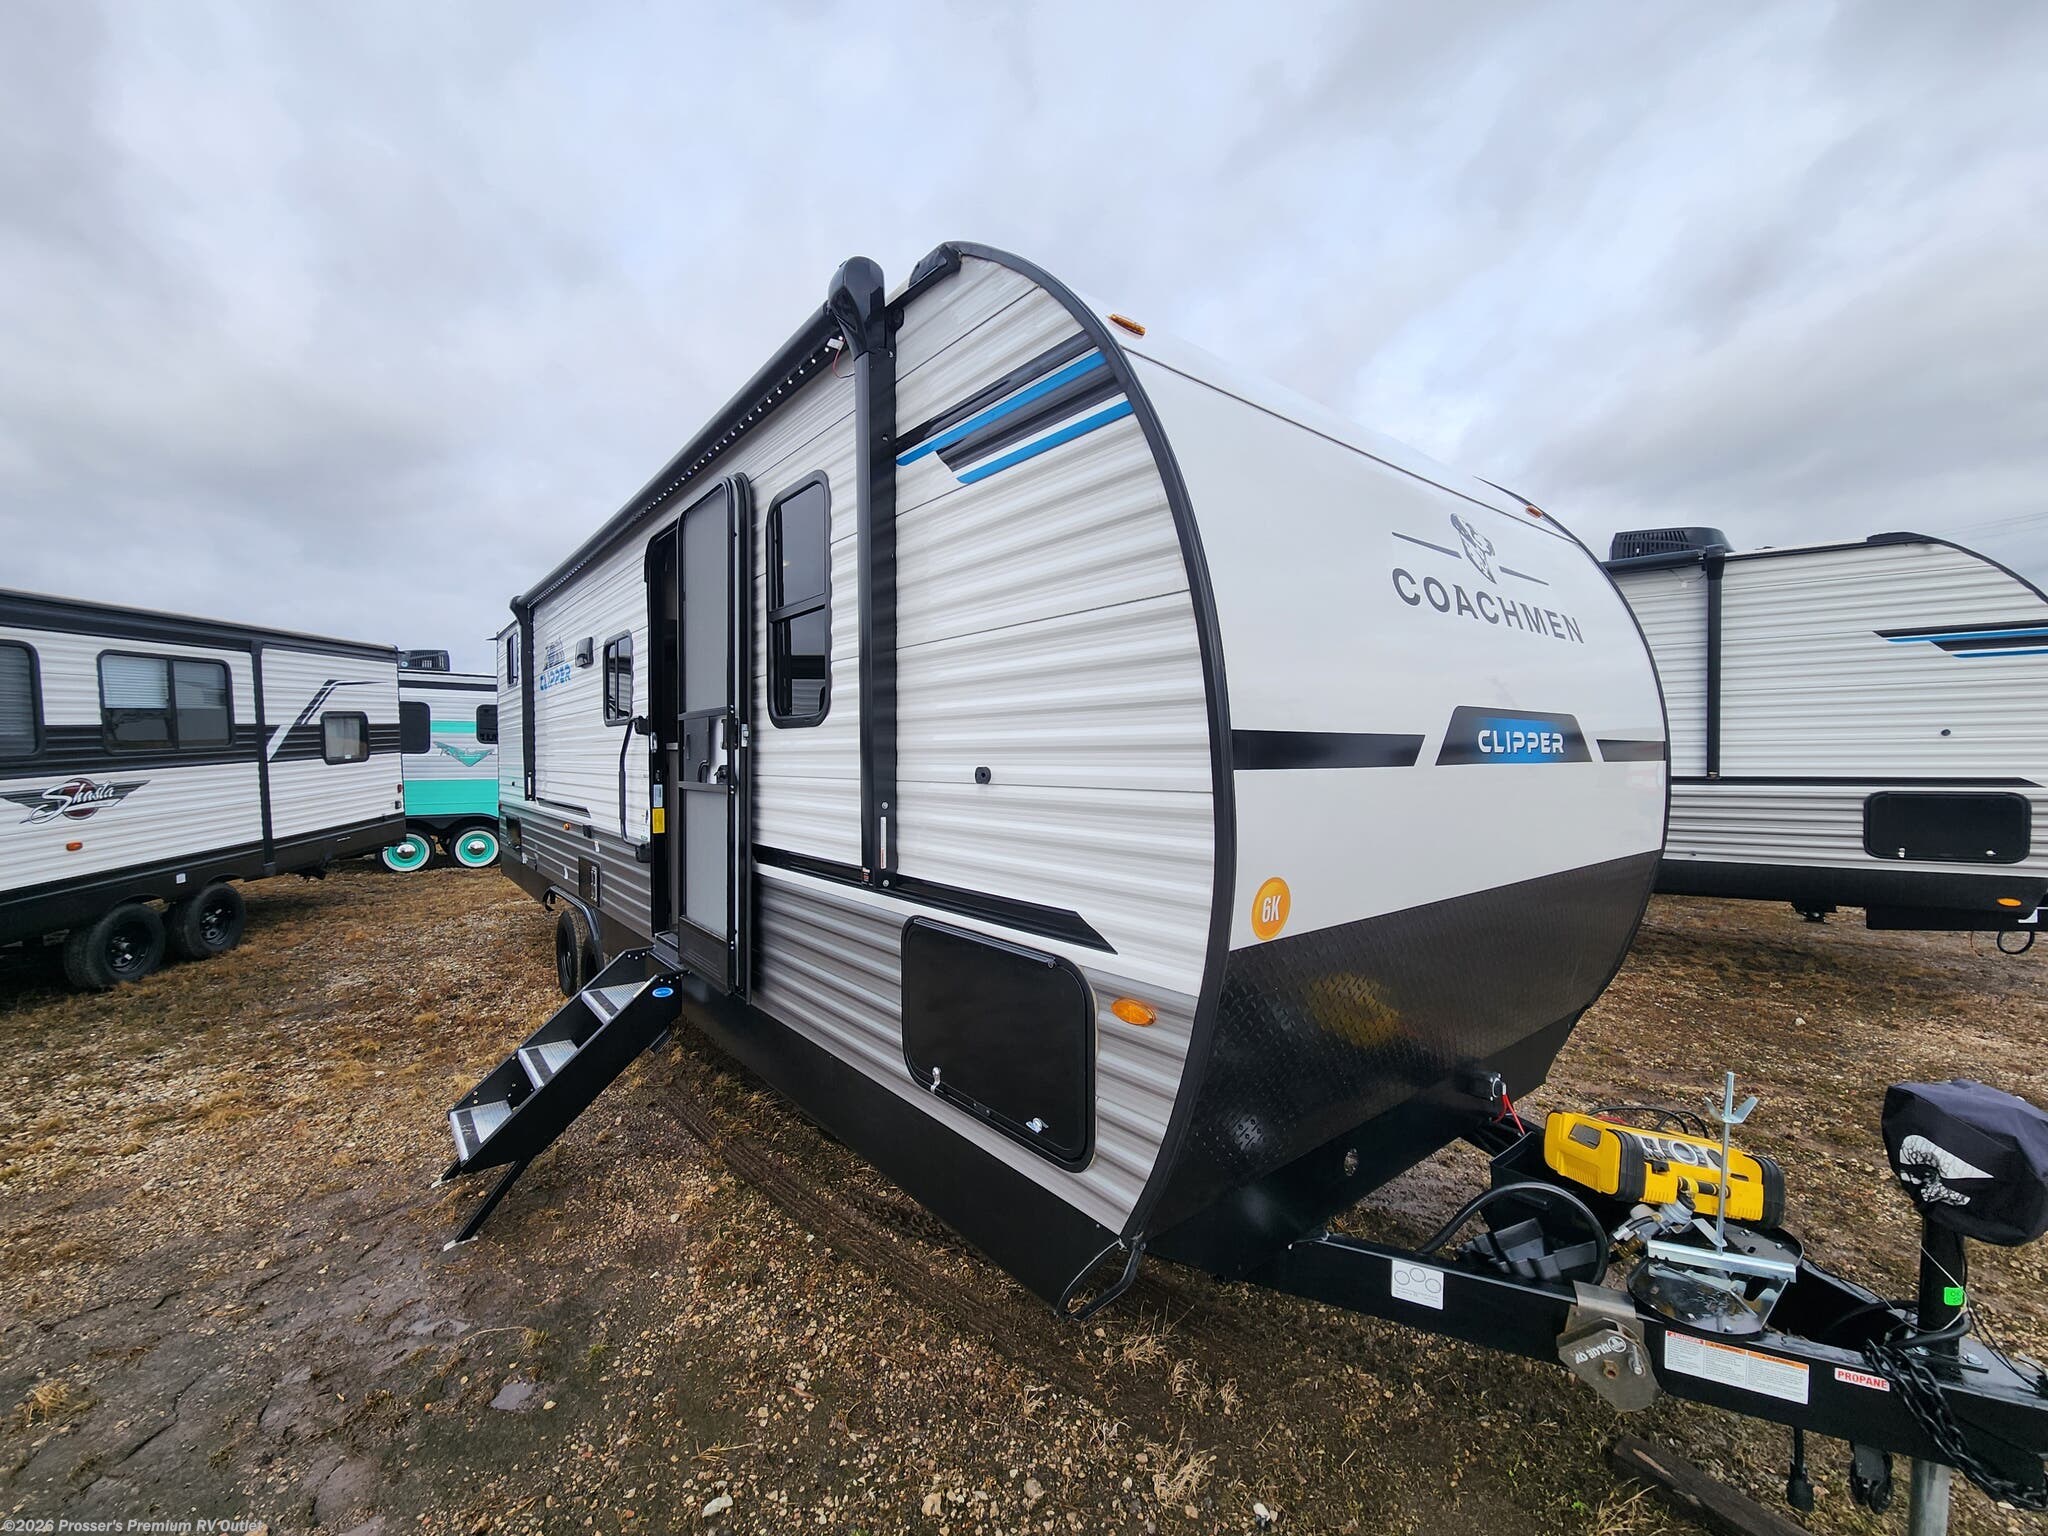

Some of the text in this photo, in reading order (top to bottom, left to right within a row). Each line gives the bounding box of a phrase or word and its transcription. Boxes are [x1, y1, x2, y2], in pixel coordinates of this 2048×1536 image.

[1392, 567, 1584, 644] COACHMEN
[540, 664, 571, 691] CLIPPER
[1478, 729, 1564, 754] CLIPPER
[27, 780, 115, 824] Shasta
[1262, 895, 1281, 923] 6K
[1837, 1370, 1888, 1389] PROPANE
